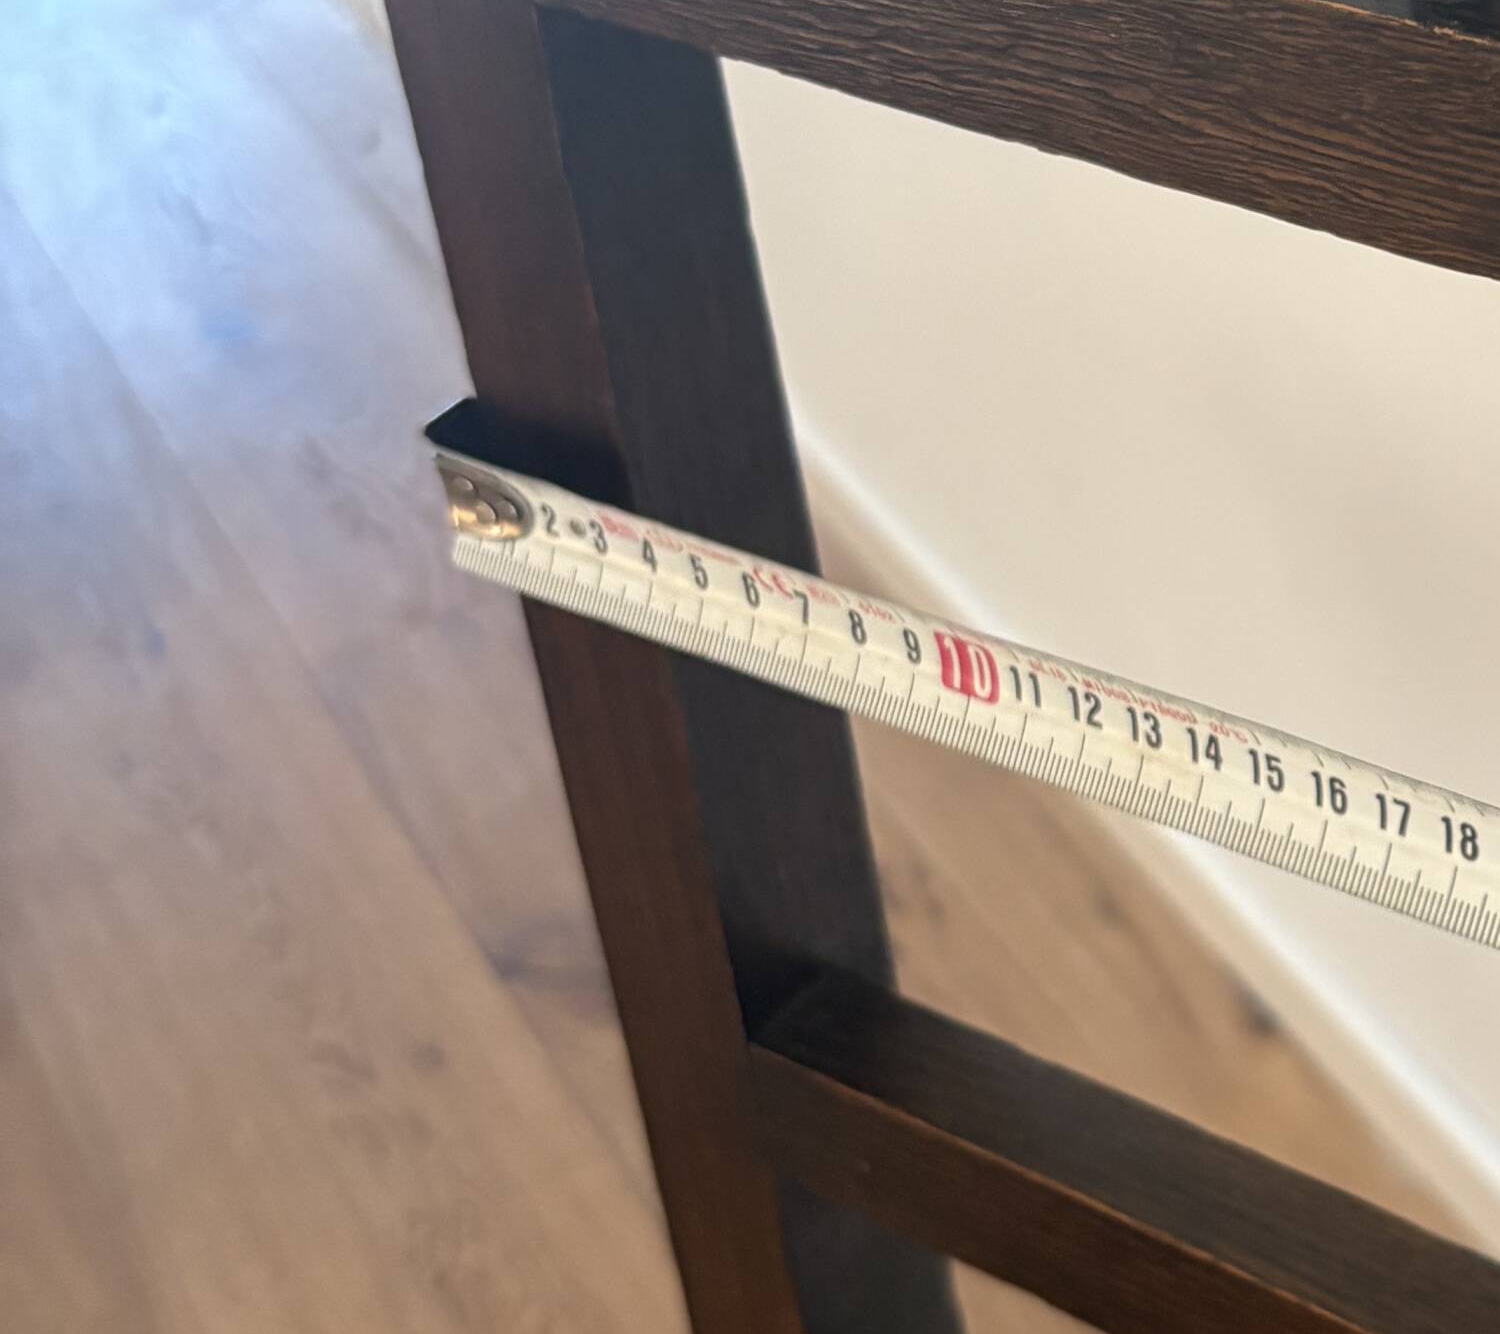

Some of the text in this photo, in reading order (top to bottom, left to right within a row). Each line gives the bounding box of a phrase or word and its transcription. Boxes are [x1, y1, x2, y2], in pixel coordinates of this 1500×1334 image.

[540, 502, 560, 538] 2
[589, 519, 608, 555] 3
[642, 537, 658, 574] 4
[688, 552, 708, 590] 5
[742, 571, 760, 609] 6
[792, 588, 810, 627] 7
[848, 609, 867, 646] 8
[903, 627, 921, 665] 9
[943, 634, 992, 700] 10
[1010, 665, 1042, 708] 11
[1068, 685, 1103, 731] 12
[1127, 706, 1163, 750] 13
[1187, 727, 1223, 772] 14
[1249, 748, 1285, 793] 15
[1311, 770, 1348, 816] 16
[1376, 793, 1411, 837] 17
[1441, 816, 1479, 862] 18
